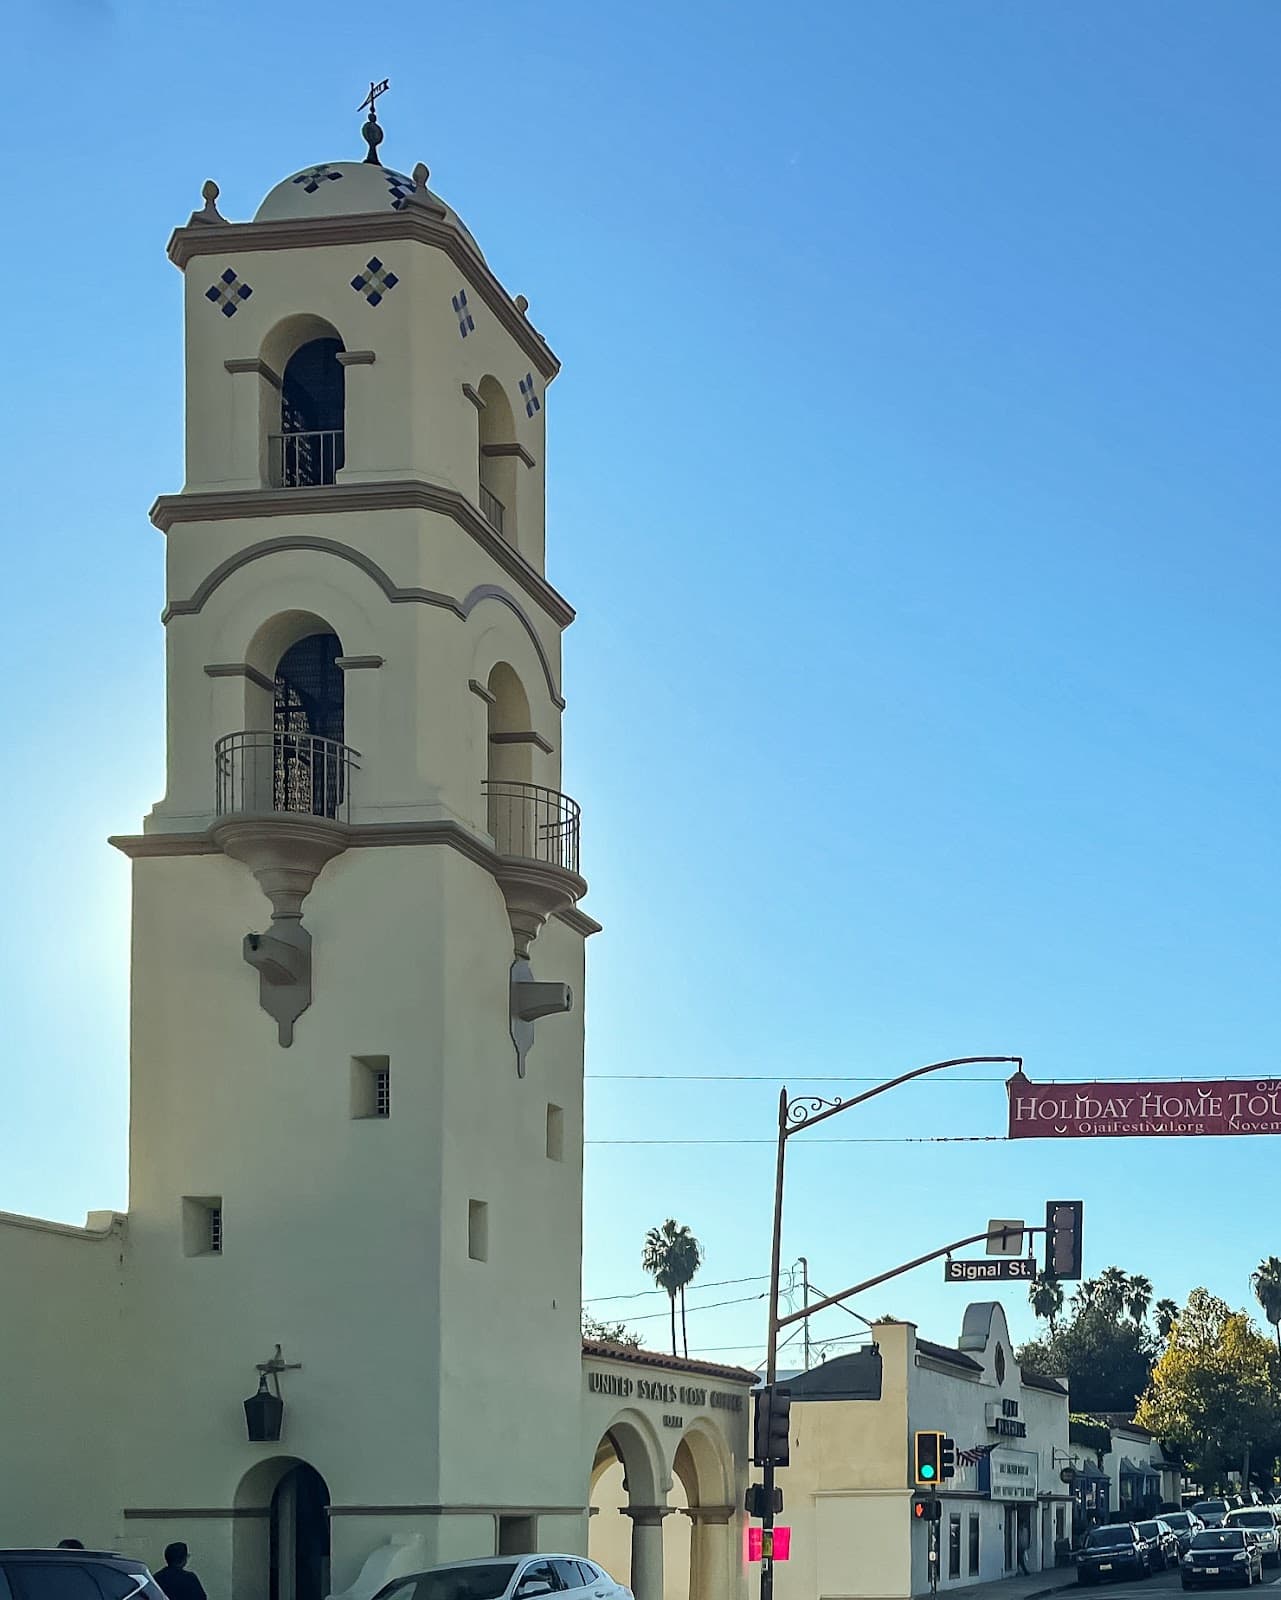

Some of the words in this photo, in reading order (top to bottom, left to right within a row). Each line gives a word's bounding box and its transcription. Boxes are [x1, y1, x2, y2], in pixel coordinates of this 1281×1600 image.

[1015, 1096, 1135, 1121] HOLIDAY
[1140, 1094, 1223, 1118] HOME
[1078, 1121, 1204, 1134] OjaiFestival.org
[950, 1262, 1001, 1280] Signal
[1008, 1261, 1031, 1276] St.
[589, 1372, 634, 1397] UNITED
[637, 1379, 677, 1402] STATES
[680, 1385, 709, 1407] POST
